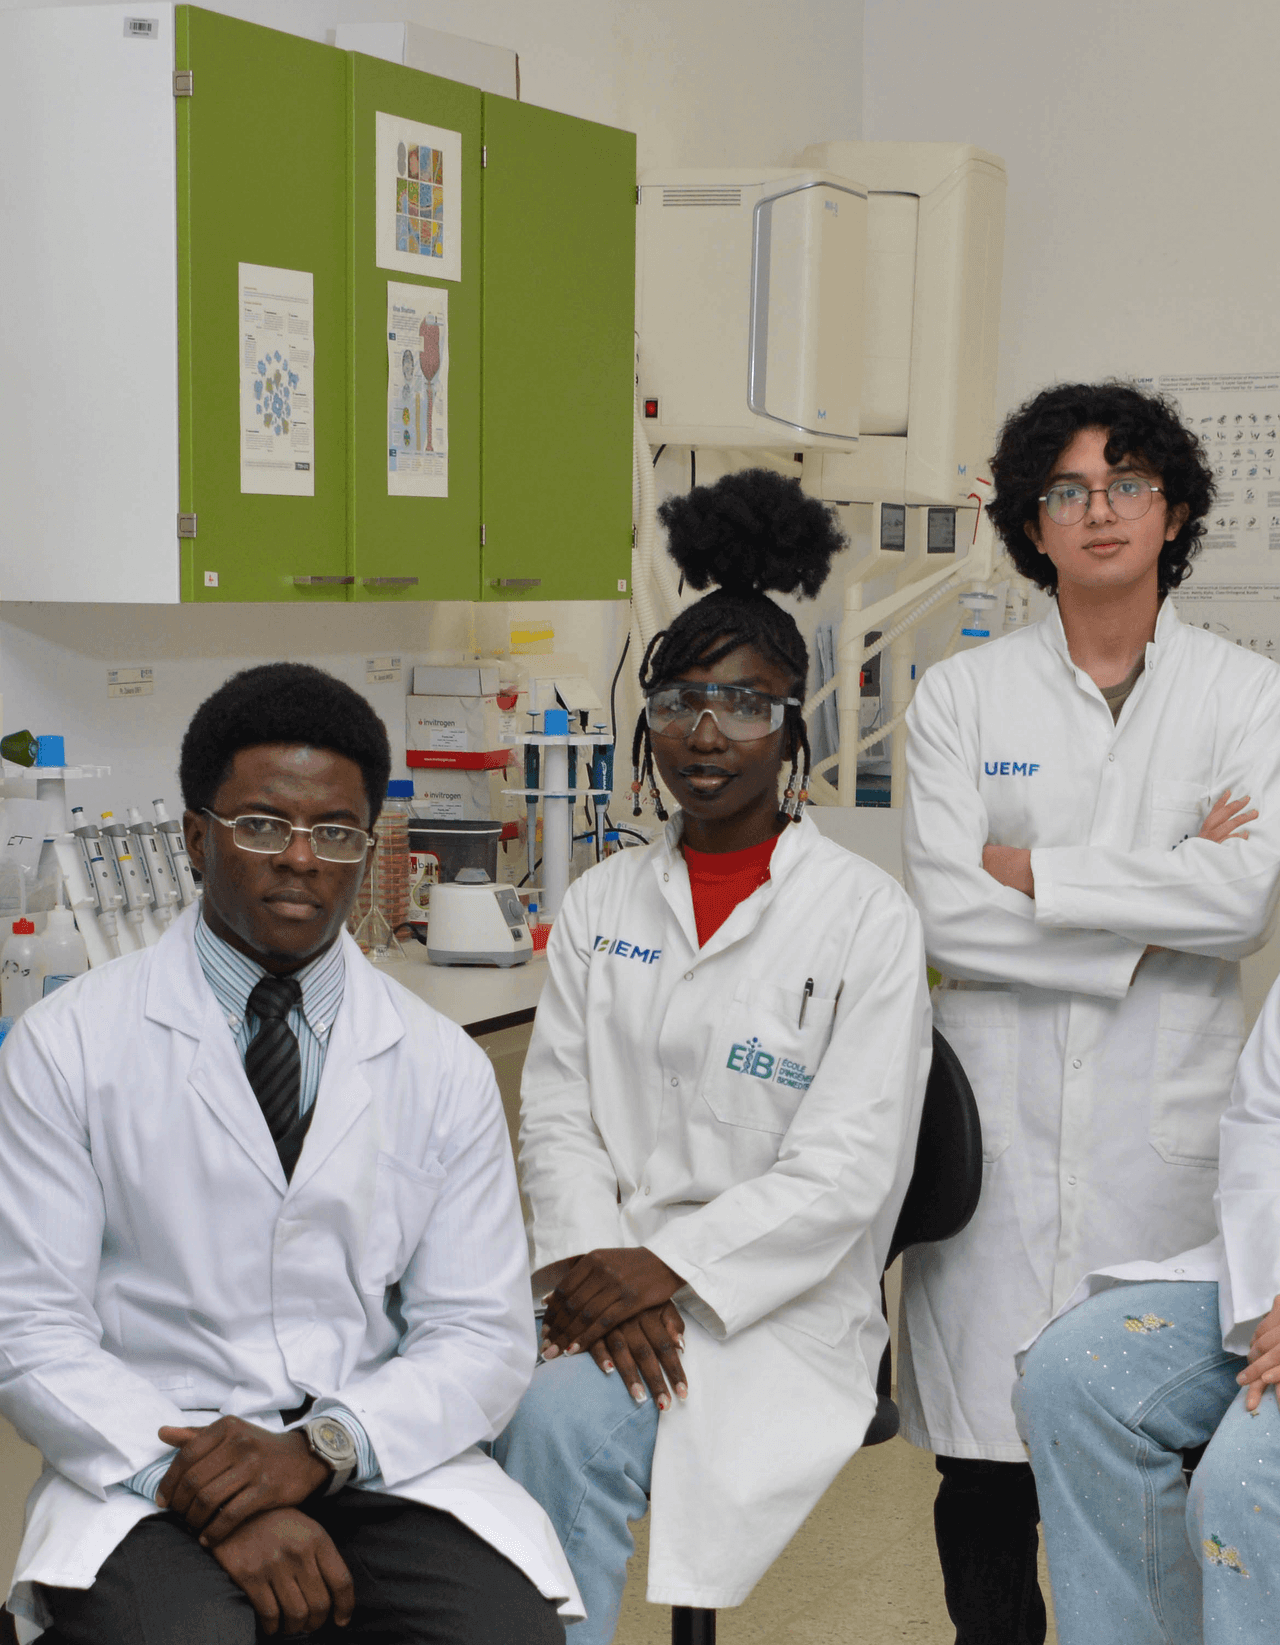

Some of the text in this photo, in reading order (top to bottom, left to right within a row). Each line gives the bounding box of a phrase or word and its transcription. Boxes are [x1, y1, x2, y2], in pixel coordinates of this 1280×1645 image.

[424, 718, 455, 728] invitrogen
[984, 761, 1040, 776] UEMF
[430, 791, 461, 800] invitrogen
